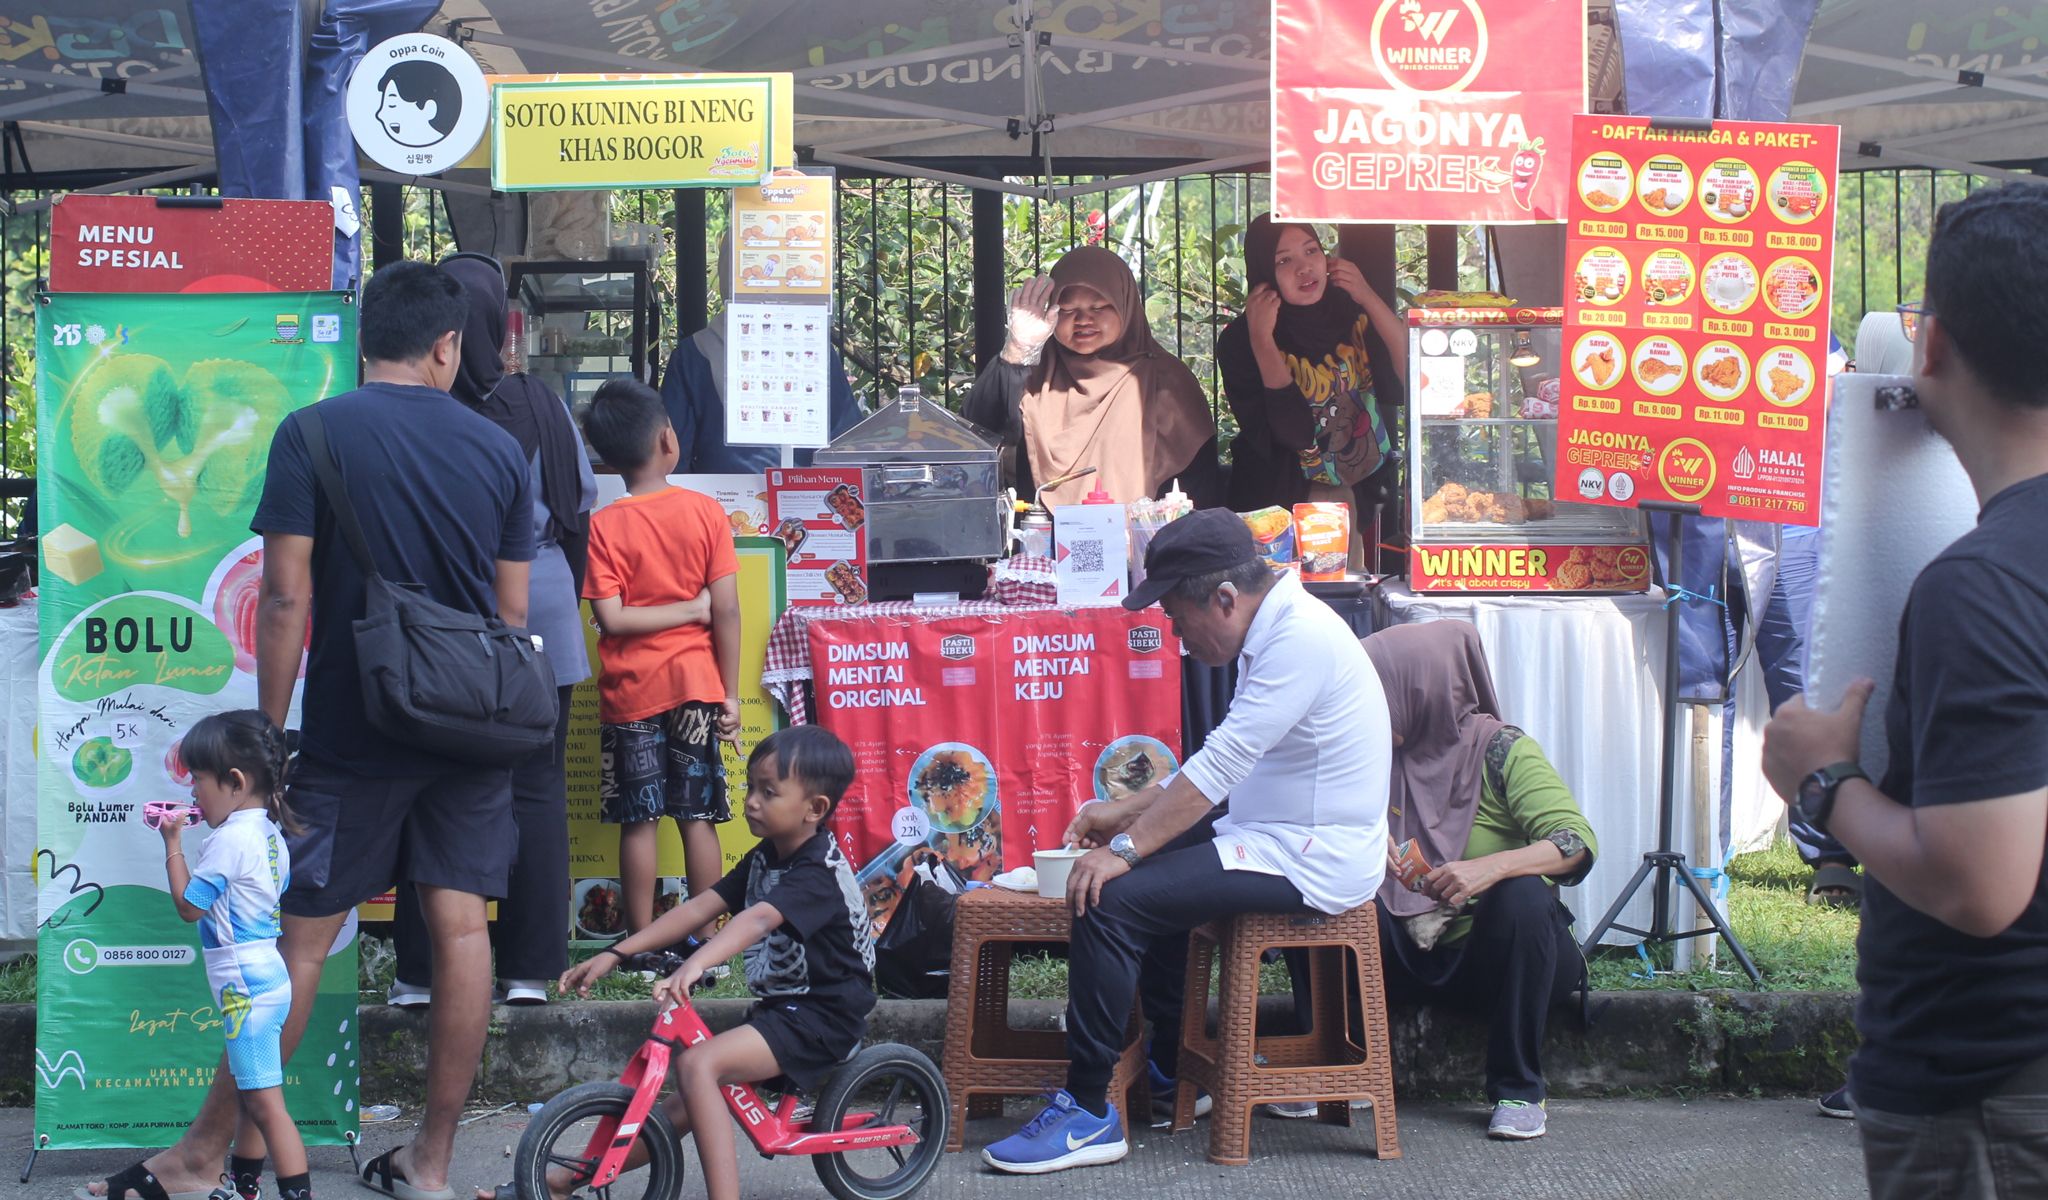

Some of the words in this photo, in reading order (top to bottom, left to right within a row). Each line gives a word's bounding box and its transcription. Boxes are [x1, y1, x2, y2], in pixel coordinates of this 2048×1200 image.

[390, 45, 417, 58] Oppa
[421, 45, 445, 59] Coin
[1386, 47, 1472, 64] WINNER
[505, 103, 566, 127] SOTO
[571, 101, 658, 126] KUNING
[665, 100, 685, 124] BI
[691, 98, 754, 123] NENG
[1313, 108, 1528, 148] JAGONYA
[1602, 124, 1668, 141] DAFTAR
[1672, 129, 1733, 145] HARGA
[1737, 131, 1750, 145] &
[560, 137, 618, 162] KHAS
[623, 135, 704, 161] BOGOR
[1312, 152, 1501, 193] GEPREK
[78, 225, 154, 244] MENU
[78, 248, 184, 269] SPESIAL
[1419, 308, 1509, 323] JAGONYA
[1589, 340, 1610, 348] SAYAP
[1568, 428, 1650, 450] JAGONYA
[1567, 447, 1641, 471] GEPREK
[1759, 449, 1805, 467] HALAL
[788, 474, 817, 484] Pilihan
[818, 475, 842, 483] Menu
[1758, 466, 1804, 476] INDONESIA
[1580, 479, 1602, 489] NKV
[1668, 475, 1704, 486] WINNER
[1773, 489, 1805, 498] FRANCHISE
[1739, 496, 1761, 507] 0811
[1765, 499, 1783, 509] 217
[1786, 500, 1804, 511] 750
[1420, 548, 1547, 577] WINNER
[1468, 578, 1499, 587] about
[1501, 579, 1530, 589] crispy
[85, 616, 193, 654] BOLU
[1132, 630, 1157, 638] PASTI
[945, 639, 970, 647] PASTI
[1013, 633, 1095, 653] DIMSUM
[1128, 638, 1162, 647] SIBEKU
[828, 642, 909, 662] DIMSUM
[940, 647, 975, 655] SIBEKU
[60, 652, 139, 689] Ketan
[153, 651, 226, 684] Lumer
[1013, 657, 1089, 677] MENTAI
[828, 665, 903, 686] MENTAI
[829, 687, 926, 709] ORIGINAL
[1015, 681, 1064, 701] KEJU
[54, 713, 91, 752] Harga
[97, 692, 146, 717] Mulai
[150, 705, 176, 728] dari
[68, 801, 95, 813] Bolu
[98, 802, 135, 813] Lumer
[76, 812, 127, 823] PANDAN
[902, 812, 918, 822] only
[901, 826, 921, 837] 22K
[104, 950, 134, 960] 0856
[136, 950, 160, 960] 800
[162, 949, 187, 960] 0127
[150, 1068, 188, 1077] UMKM
[95, 1078, 180, 1088] KECAMATAN
